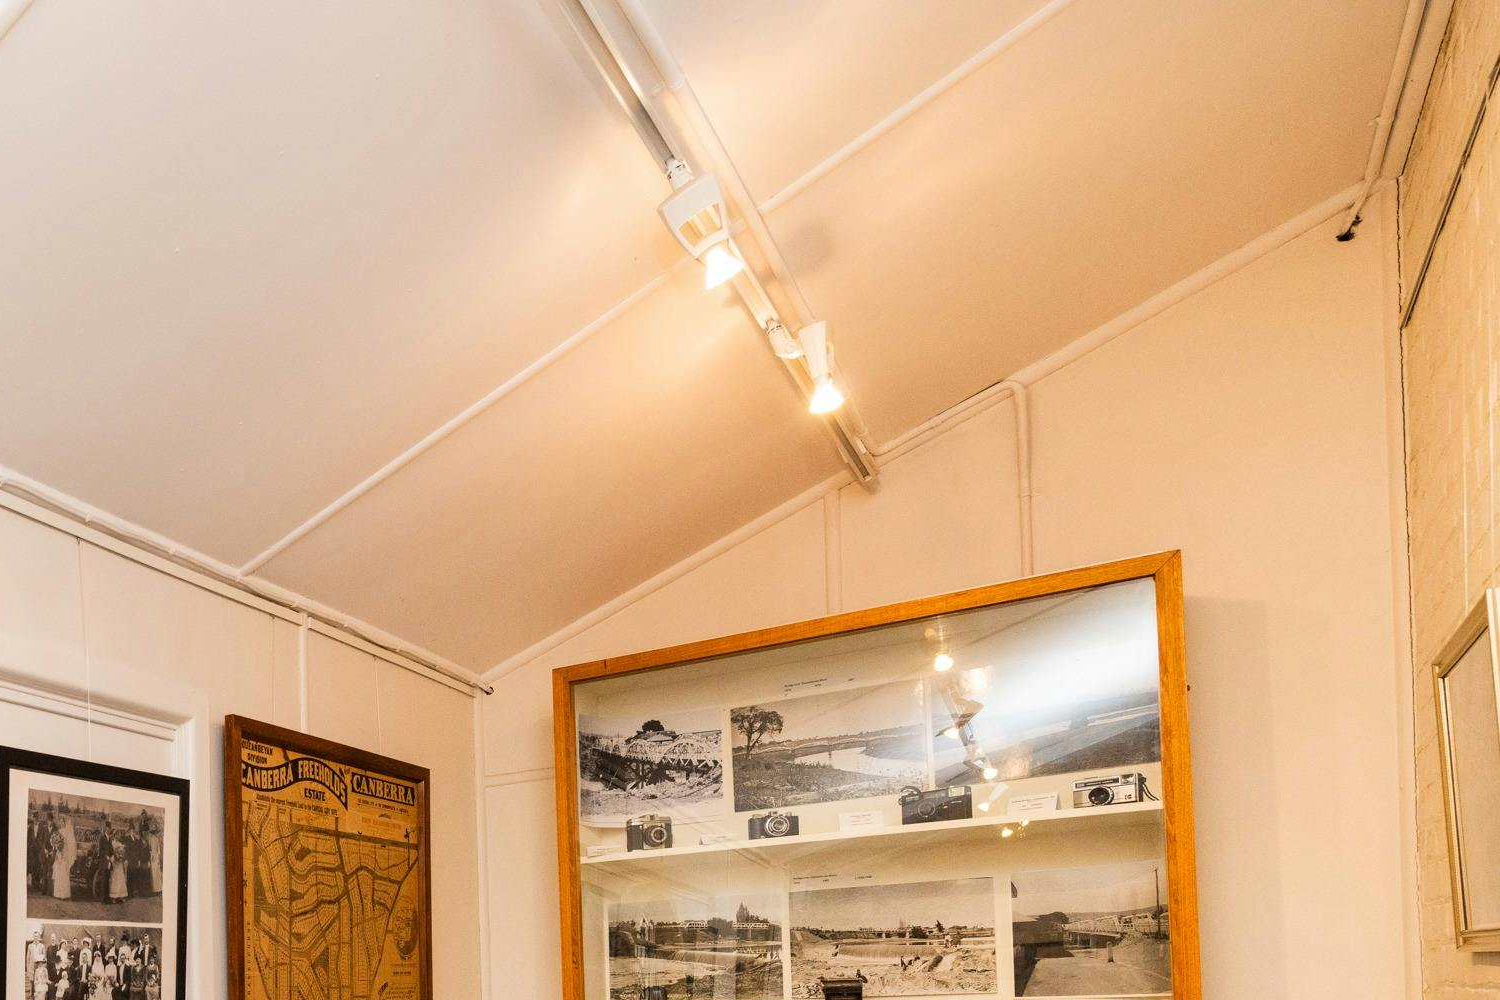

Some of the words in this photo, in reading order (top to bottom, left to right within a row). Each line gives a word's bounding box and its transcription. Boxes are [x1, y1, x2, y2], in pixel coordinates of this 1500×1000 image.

[242, 761, 294, 789] CANBERRA
[298, 760, 346, 803] FREEHOLDS
[304, 788, 326, 801] ESTATE
[352, 774, 414, 805] CANBERRA
